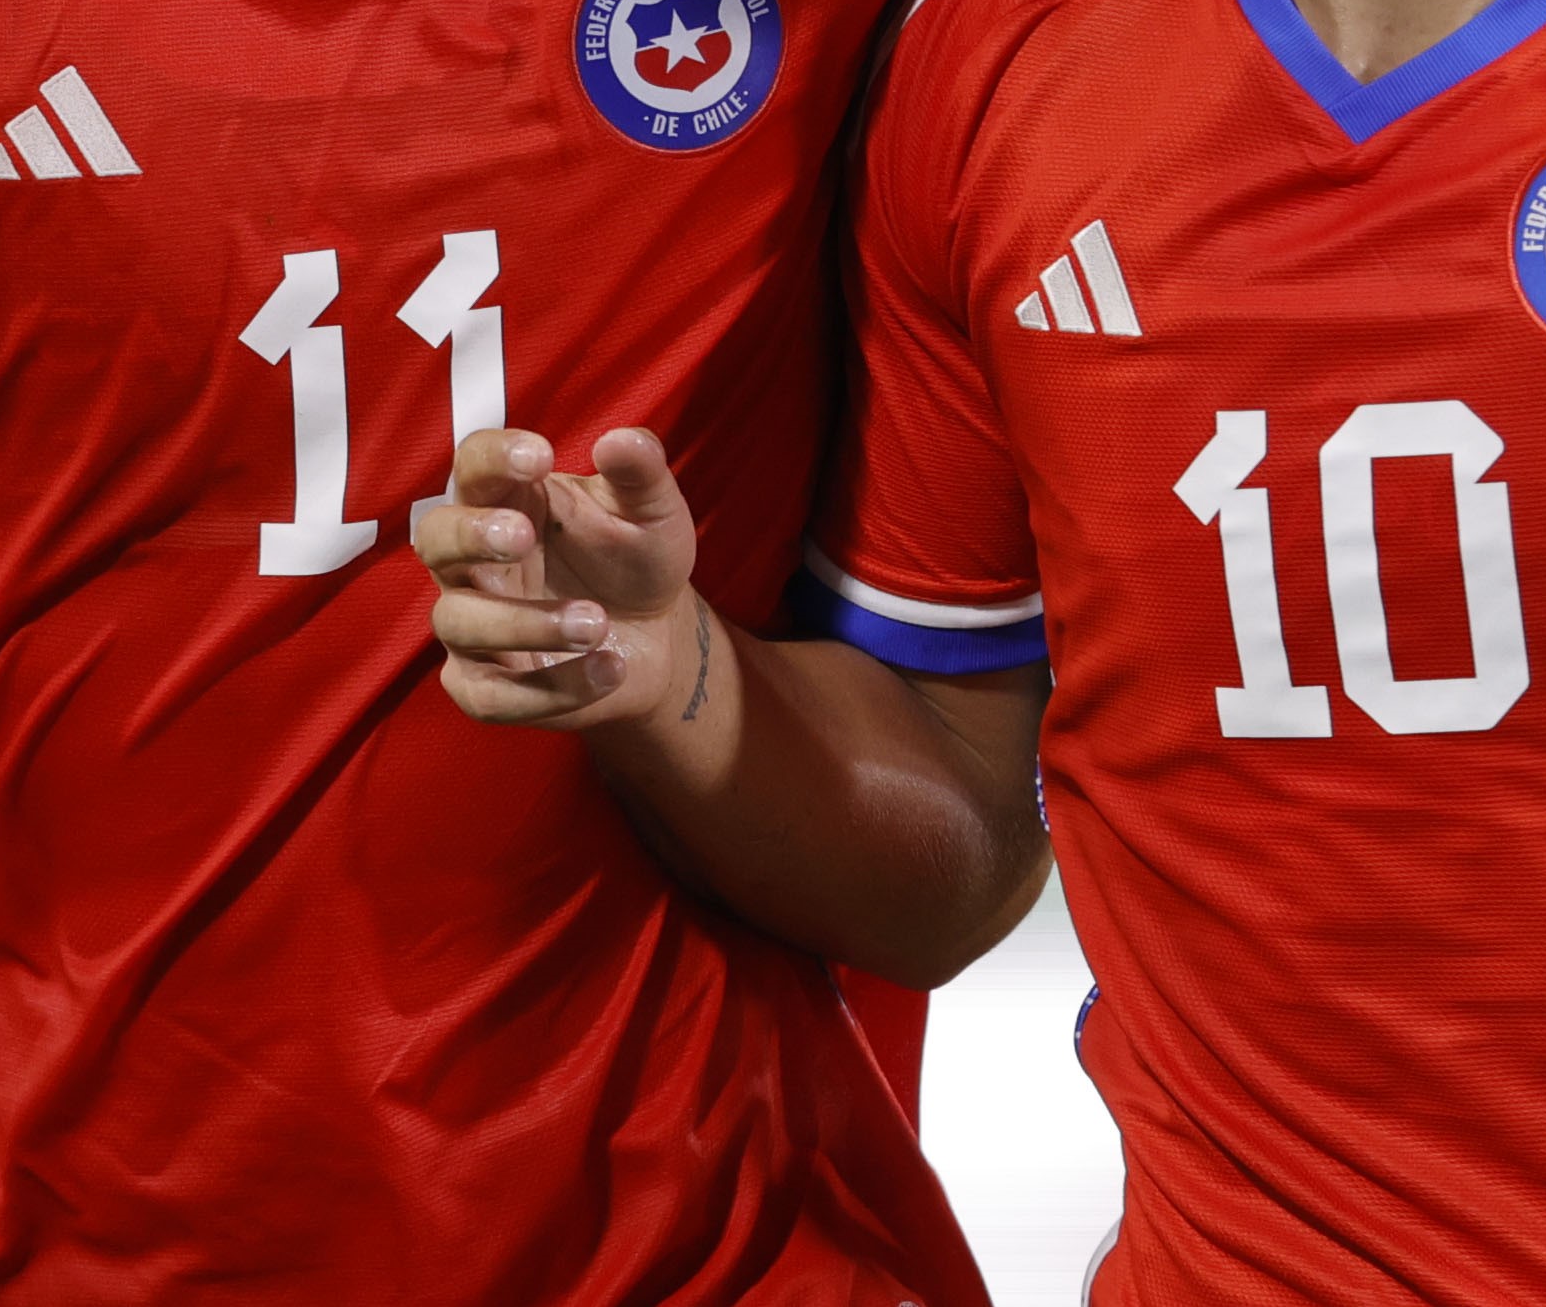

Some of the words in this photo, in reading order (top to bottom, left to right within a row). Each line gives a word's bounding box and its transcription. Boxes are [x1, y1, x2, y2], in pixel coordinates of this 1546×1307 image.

[652, 113, 679, 137] DE
[693, 91, 748, 136] CHILE
[238, 229, 507, 576] 11
[1172, 399, 1531, 738] 10
